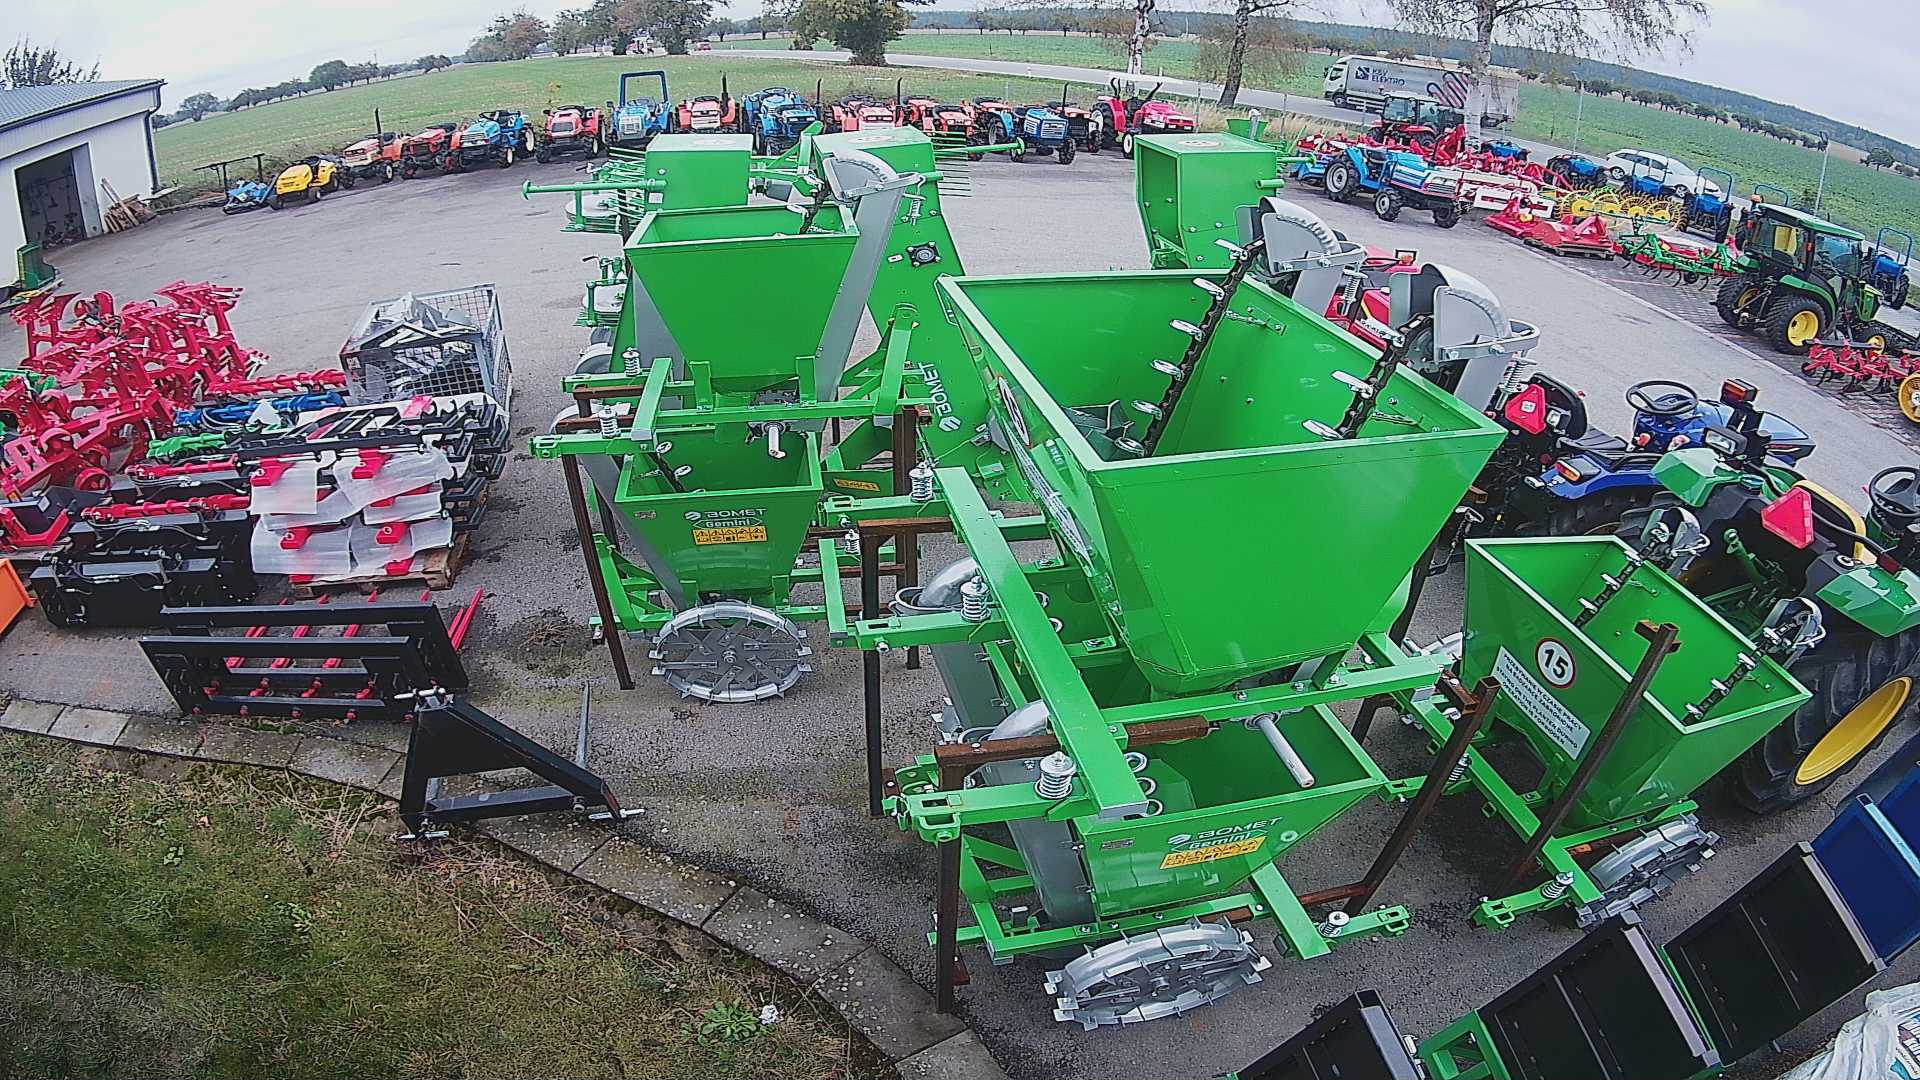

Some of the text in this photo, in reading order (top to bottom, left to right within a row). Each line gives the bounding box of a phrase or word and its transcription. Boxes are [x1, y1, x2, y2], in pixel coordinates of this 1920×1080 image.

[1372, 76, 1405, 86] ELEKTRO
[918, 362, 952, 416] BOMET
[704, 508, 767, 518] BOMET
[705, 518, 751, 528] Gemini
[1544, 648, 1569, 679] 15
[1198, 816, 1283, 839] BOMET
[1189, 832, 1251, 849] Gemini
